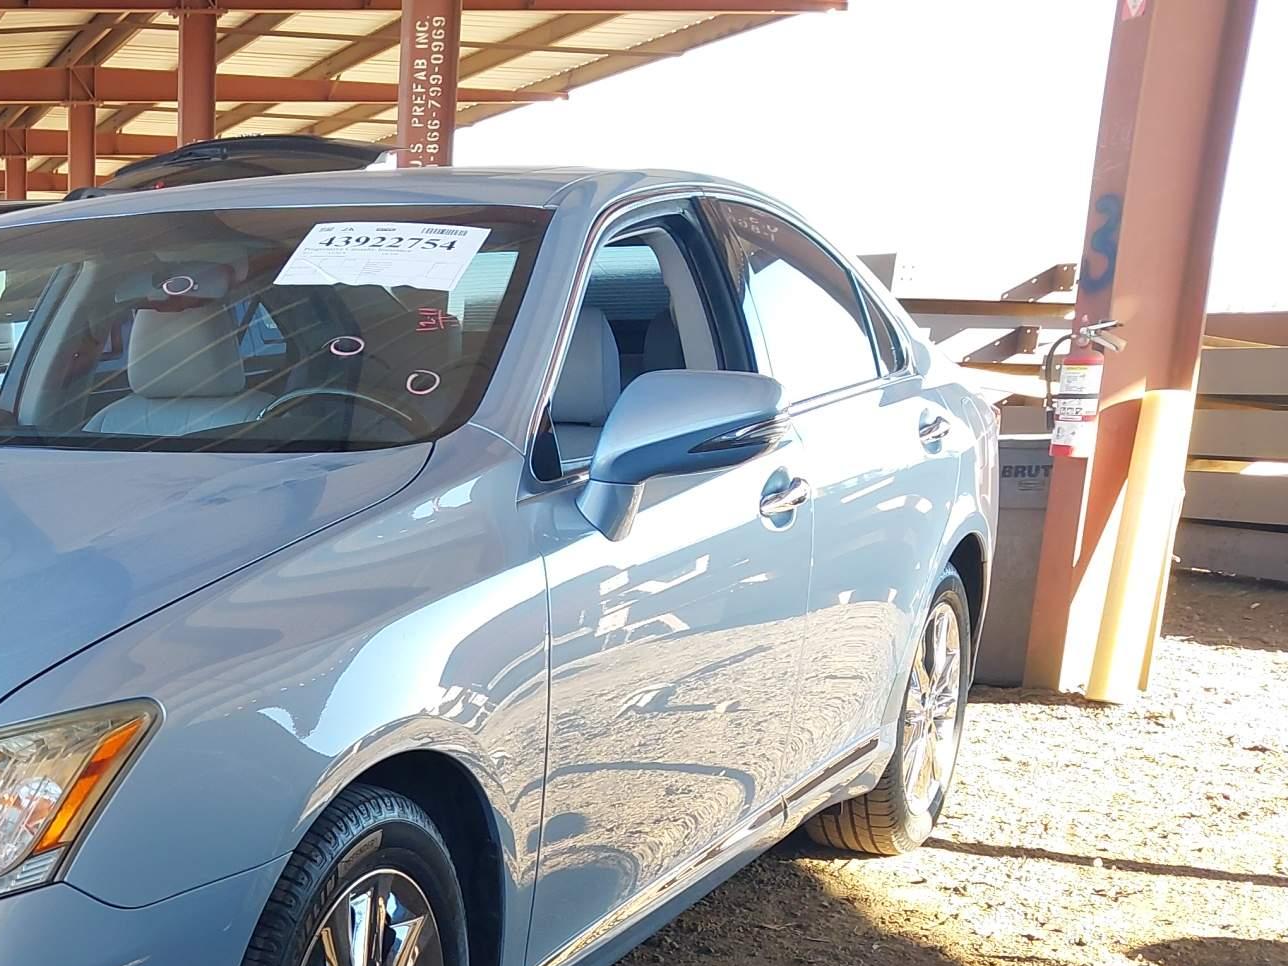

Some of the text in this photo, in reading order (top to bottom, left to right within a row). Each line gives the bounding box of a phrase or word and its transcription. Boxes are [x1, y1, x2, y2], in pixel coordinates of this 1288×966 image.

[415, 15, 430, 49] INC.
[411, 58, 428, 128] PREFAB
[319, 235, 458, 251] 43922754
